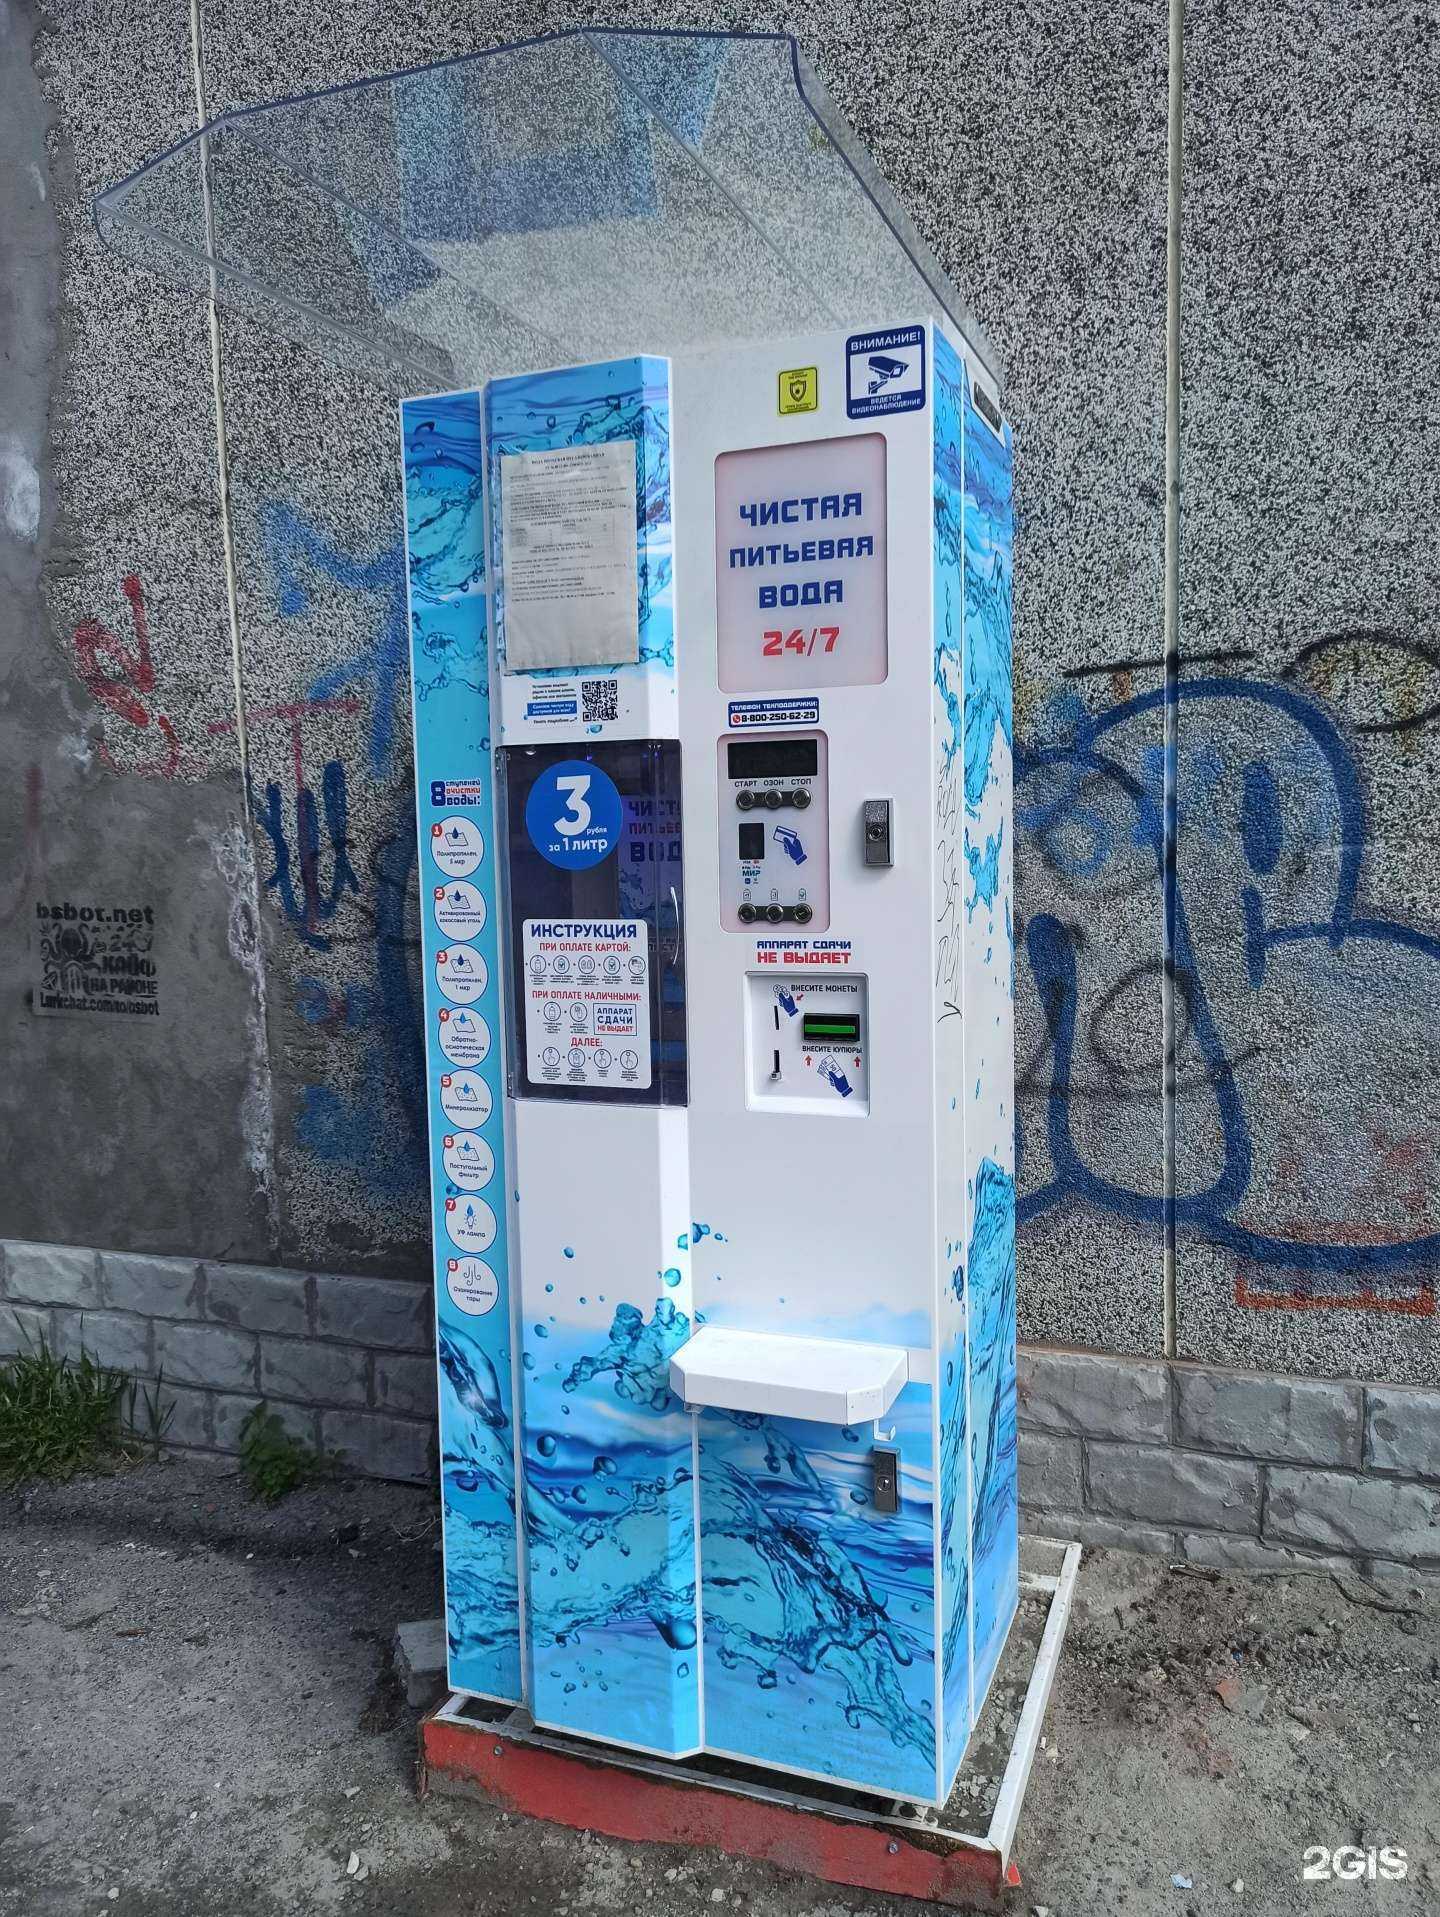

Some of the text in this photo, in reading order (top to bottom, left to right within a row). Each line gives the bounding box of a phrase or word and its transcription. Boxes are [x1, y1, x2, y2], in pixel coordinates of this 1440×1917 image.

[851, 331, 921, 351] ВНИМАНИЕ!
[870, 394, 902, 405] ВЕДЕТСЯ
[851, 398, 921, 414] ВИДЕОНАБЛЮДЕНИЕ
[740, 492, 862, 527] ЧИСТАЯ
[730, 535, 874, 568] ПИТЬЕВАЯ
[759, 579, 843, 609] ВОДА
[763, 626, 840, 657] 24/7
[731, 703, 761, 711] ТЕЛЕФОН
[742, 711, 816, 722] 8-800-250-62-29
[734, 778, 812, 788] СТАРТ ОЗОН СТОП
[431, 778, 480, 806] 8 ступеней
[446, 795, 480, 806] воды:
[554, 775, 608, 836] 3 рубля
[549, 837, 608, 852] за 1 литр
[436, 888, 443, 898] 2
[531, 924, 637, 940] ИНСТРУКЦИЯ
[540, 942, 631, 952] ПРИ ОПЛАТЕ КАРТОЙ:
[757, 940, 852, 950] АППАРАТ СДАЧИ
[757, 952, 852, 964] НЕ ВЫДАЕТ
[790, 984, 858, 993] ВНЕСИТЕ МОНЕТЫ
[532, 990, 642, 1001] ПРИ ОПЛАТЕ НАЛИЧНЫМИ:
[598, 1016, 633, 1025] СДАЧИ
[607, 1025, 633, 1033] ВЫДАЕТ
[570, 1037, 603, 1047] ДАЛЕЕ:
[802, 1045, 863, 1054] ВНЕСИТЕ КУПЮРЫ
